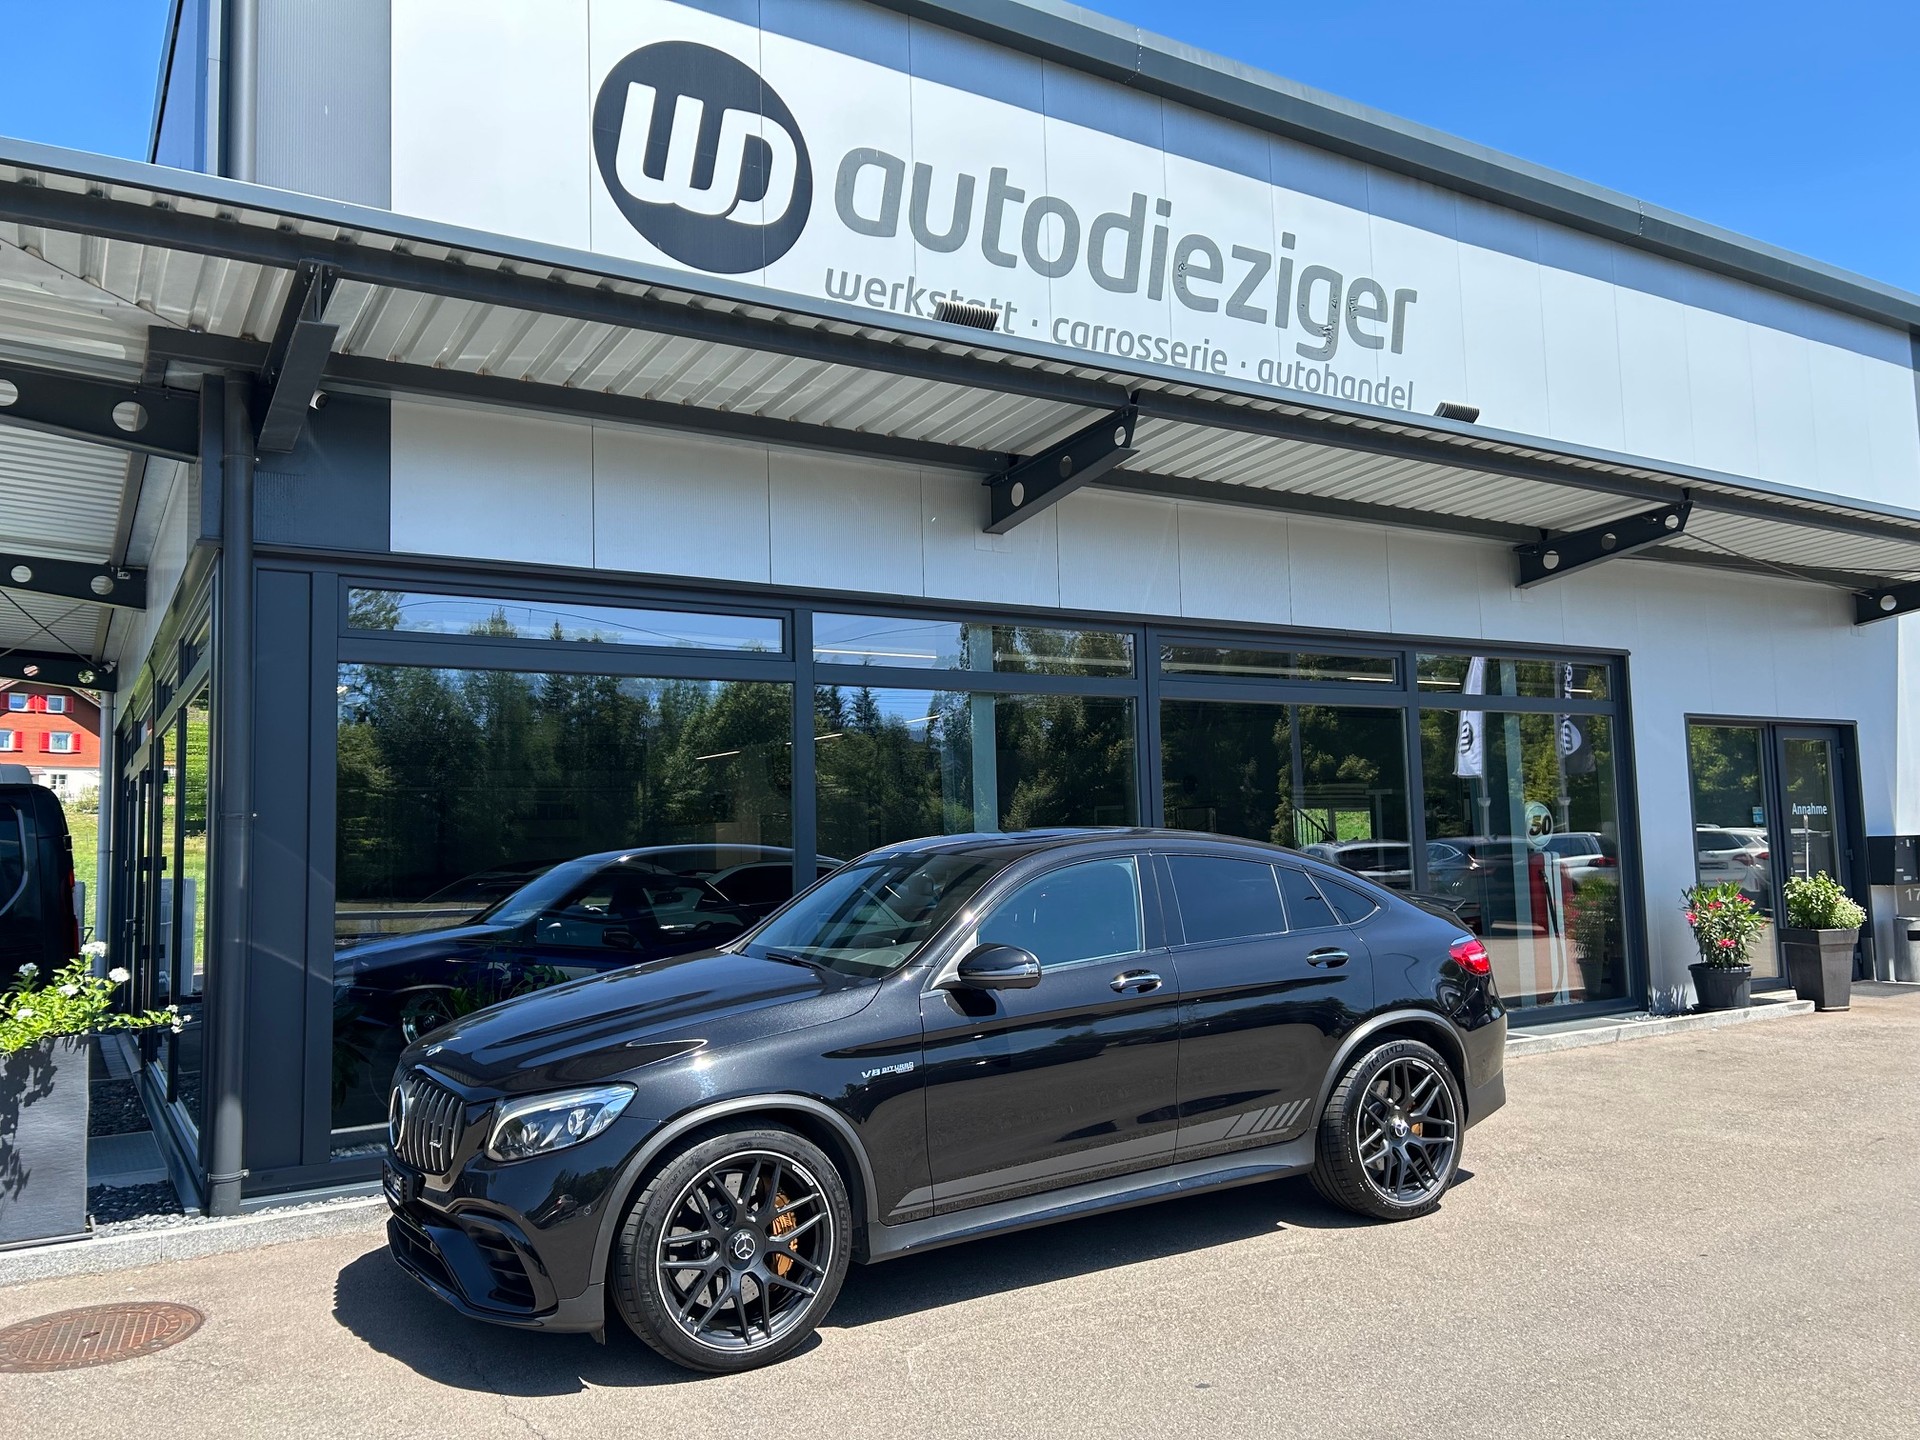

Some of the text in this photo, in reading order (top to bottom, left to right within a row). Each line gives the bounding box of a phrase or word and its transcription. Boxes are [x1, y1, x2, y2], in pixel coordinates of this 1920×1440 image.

[833, 147, 1418, 361] autodieziger
[824, 267, 1413, 411] werkst carrosserie autohandel
[1791, 803, 1828, 815] Annahme
[1529, 815, 1552, 835] 50
[861, 1069, 880, 1078] V8
